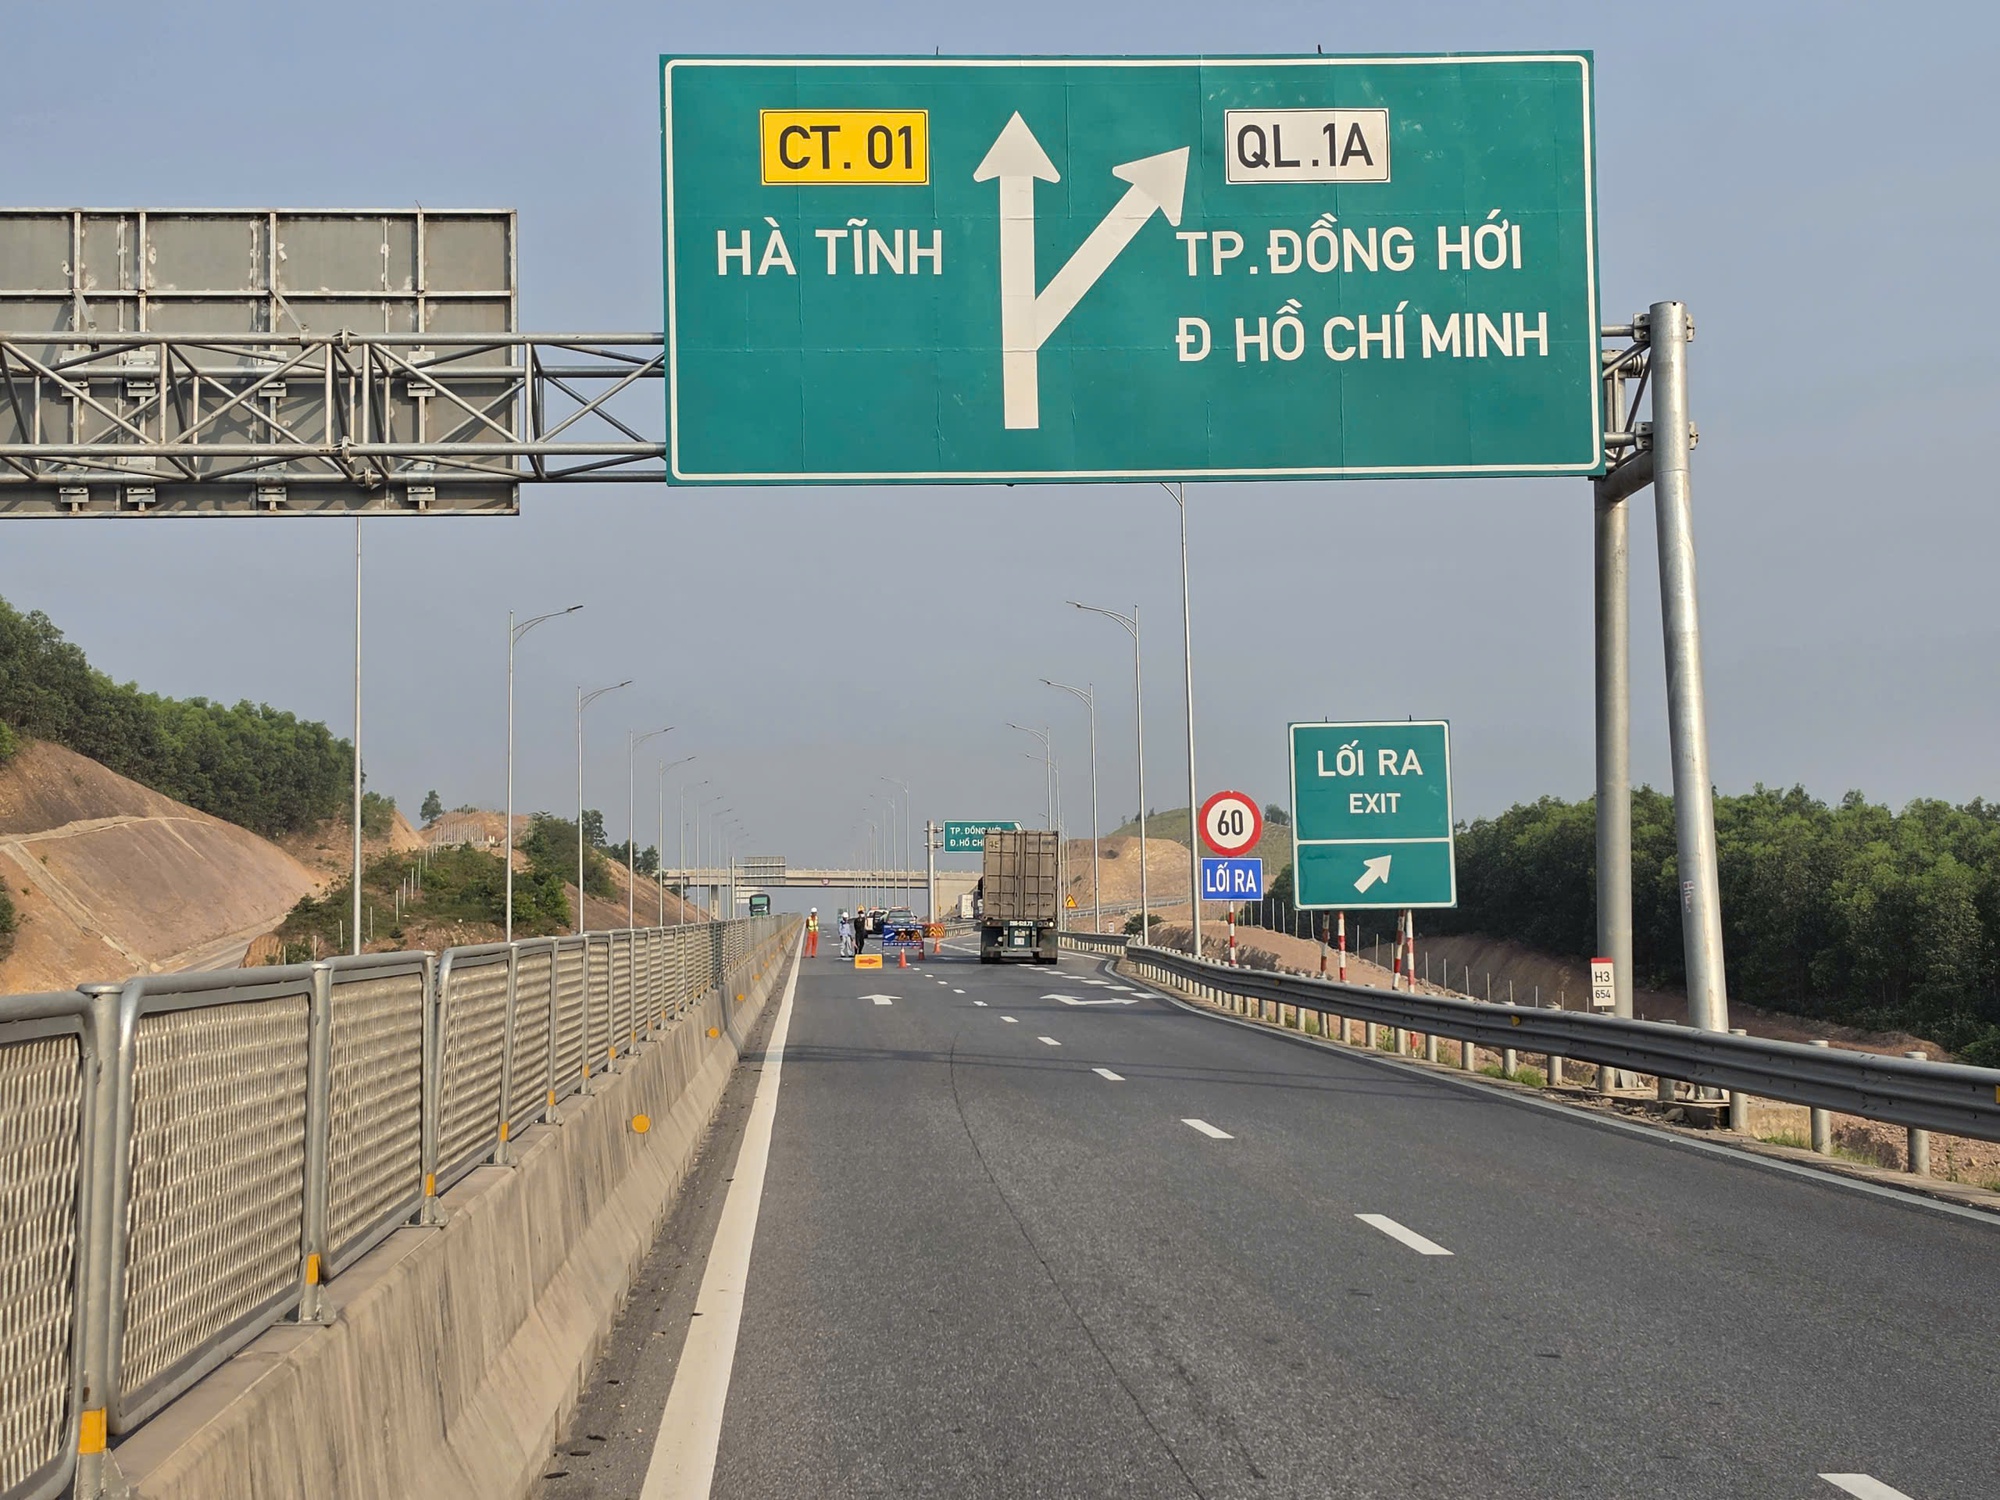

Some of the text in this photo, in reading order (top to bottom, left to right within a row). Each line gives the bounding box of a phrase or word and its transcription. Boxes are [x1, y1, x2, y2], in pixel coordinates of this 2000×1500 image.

[867, 125, 913, 170] 01
[717, 216, 943, 276] HÀ TĨNH
[1437, 208, 1522, 271] HỚI
[1175, 298, 1549, 363] Đ HỒ CHÍ MINH
[1317, 739, 1424, 777] LỐI RA
[1349, 792, 1402, 814] EXIT
[1217, 809, 1244, 836] 60
[1206, 861, 1257, 893] LỐI RA
[1594, 970, 1611, 983] H3
[1595, 989, 1611, 999] 654
